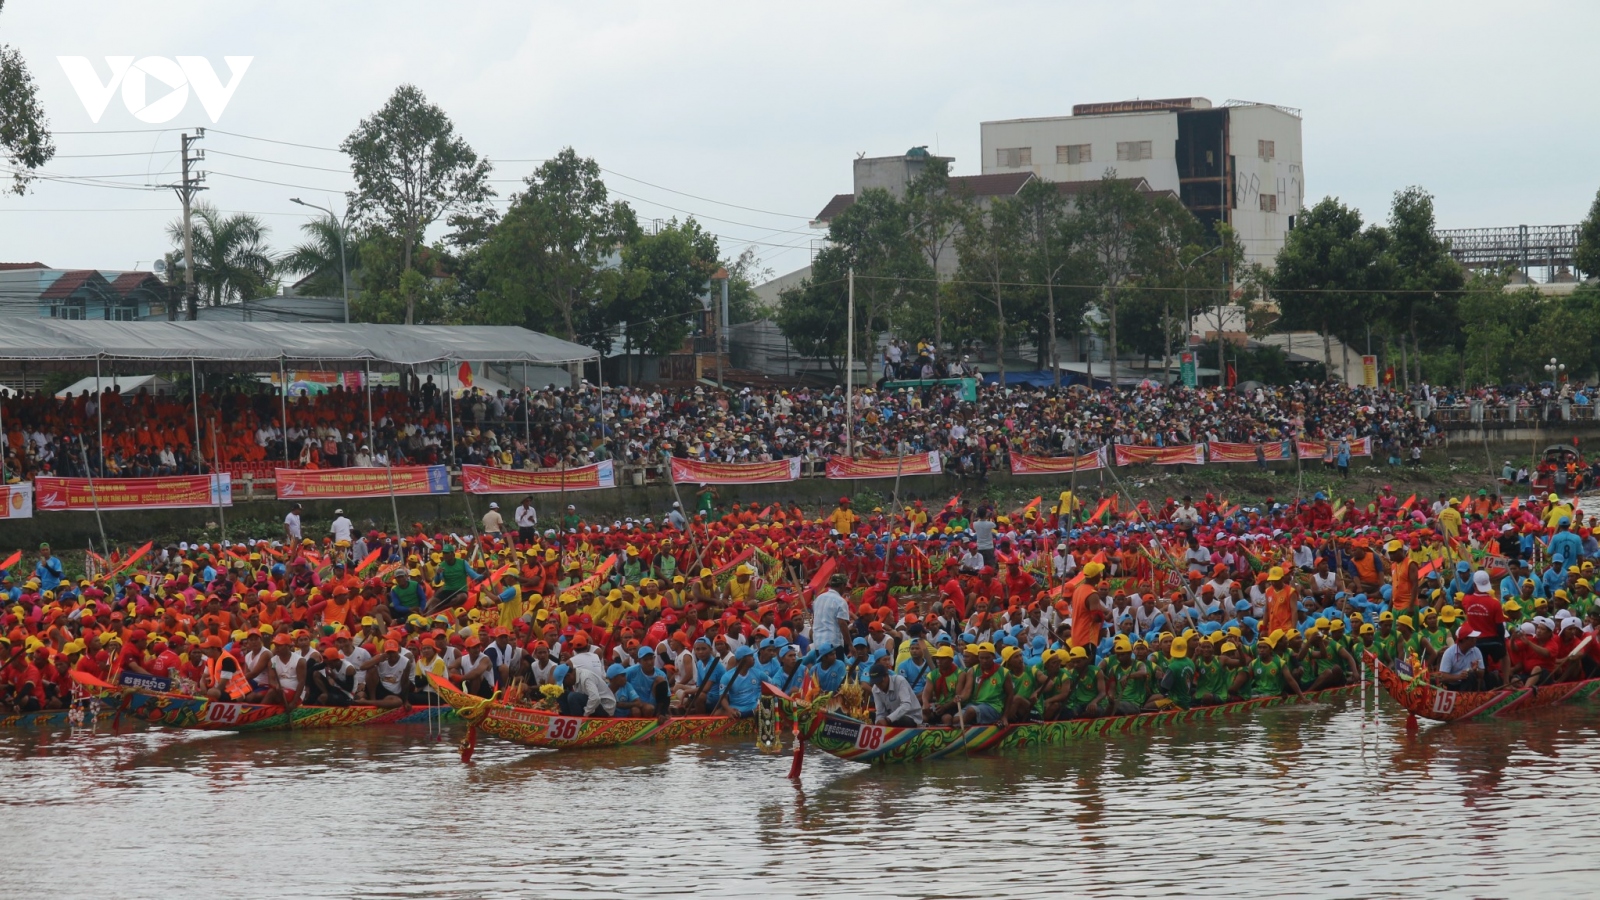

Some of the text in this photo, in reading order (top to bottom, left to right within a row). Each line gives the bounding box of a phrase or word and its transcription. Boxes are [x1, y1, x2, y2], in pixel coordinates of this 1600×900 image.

[1563, 544, 1570, 559] 8
[1484, 557, 1494, 568] 12
[149, 575, 160, 586] 17
[1169, 571, 1180, 585] 05
[1437, 691, 1453, 712] 15
[209, 703, 236, 723] 04
[550, 718, 577, 739] 36
[859, 726, 882, 749] 08
